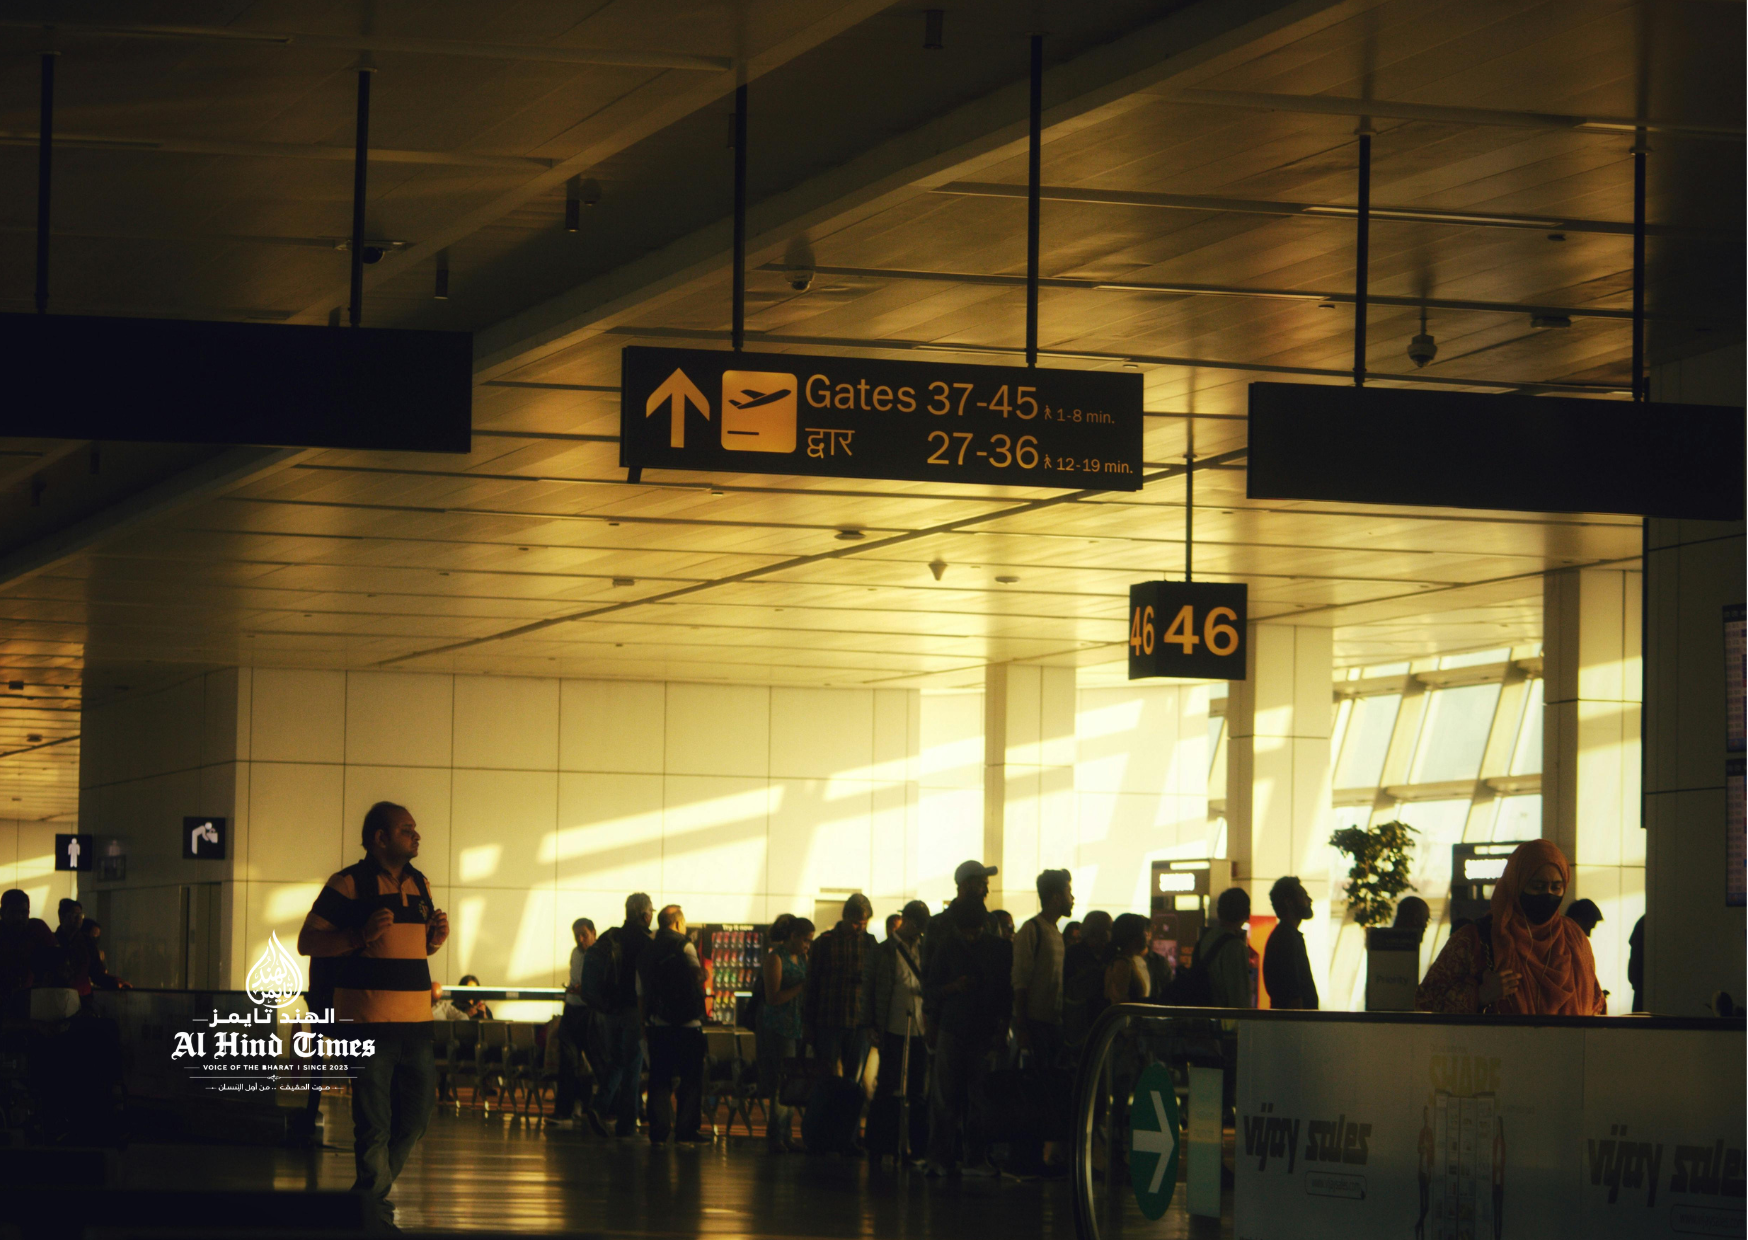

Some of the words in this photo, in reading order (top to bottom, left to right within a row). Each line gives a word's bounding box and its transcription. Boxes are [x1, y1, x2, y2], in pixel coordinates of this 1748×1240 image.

[805, 374, 917, 413] Gates
[927, 381, 1039, 420] 37-45
[1057, 408, 1083, 423] 1-8
[1086, 410, 1116, 424] min.
[804, 427, 856, 459] द्वार
[927, 430, 1039, 469] 27-36
[1056, 457, 1101, 473] 12-19
[1104, 460, 1134, 474] min.
[1130, 605, 1155, 657] 46
[1163, 605, 1239, 657] 46
[1305, 1114, 1373, 1165] sales
[1670, 1138, 1747, 1198] sale
